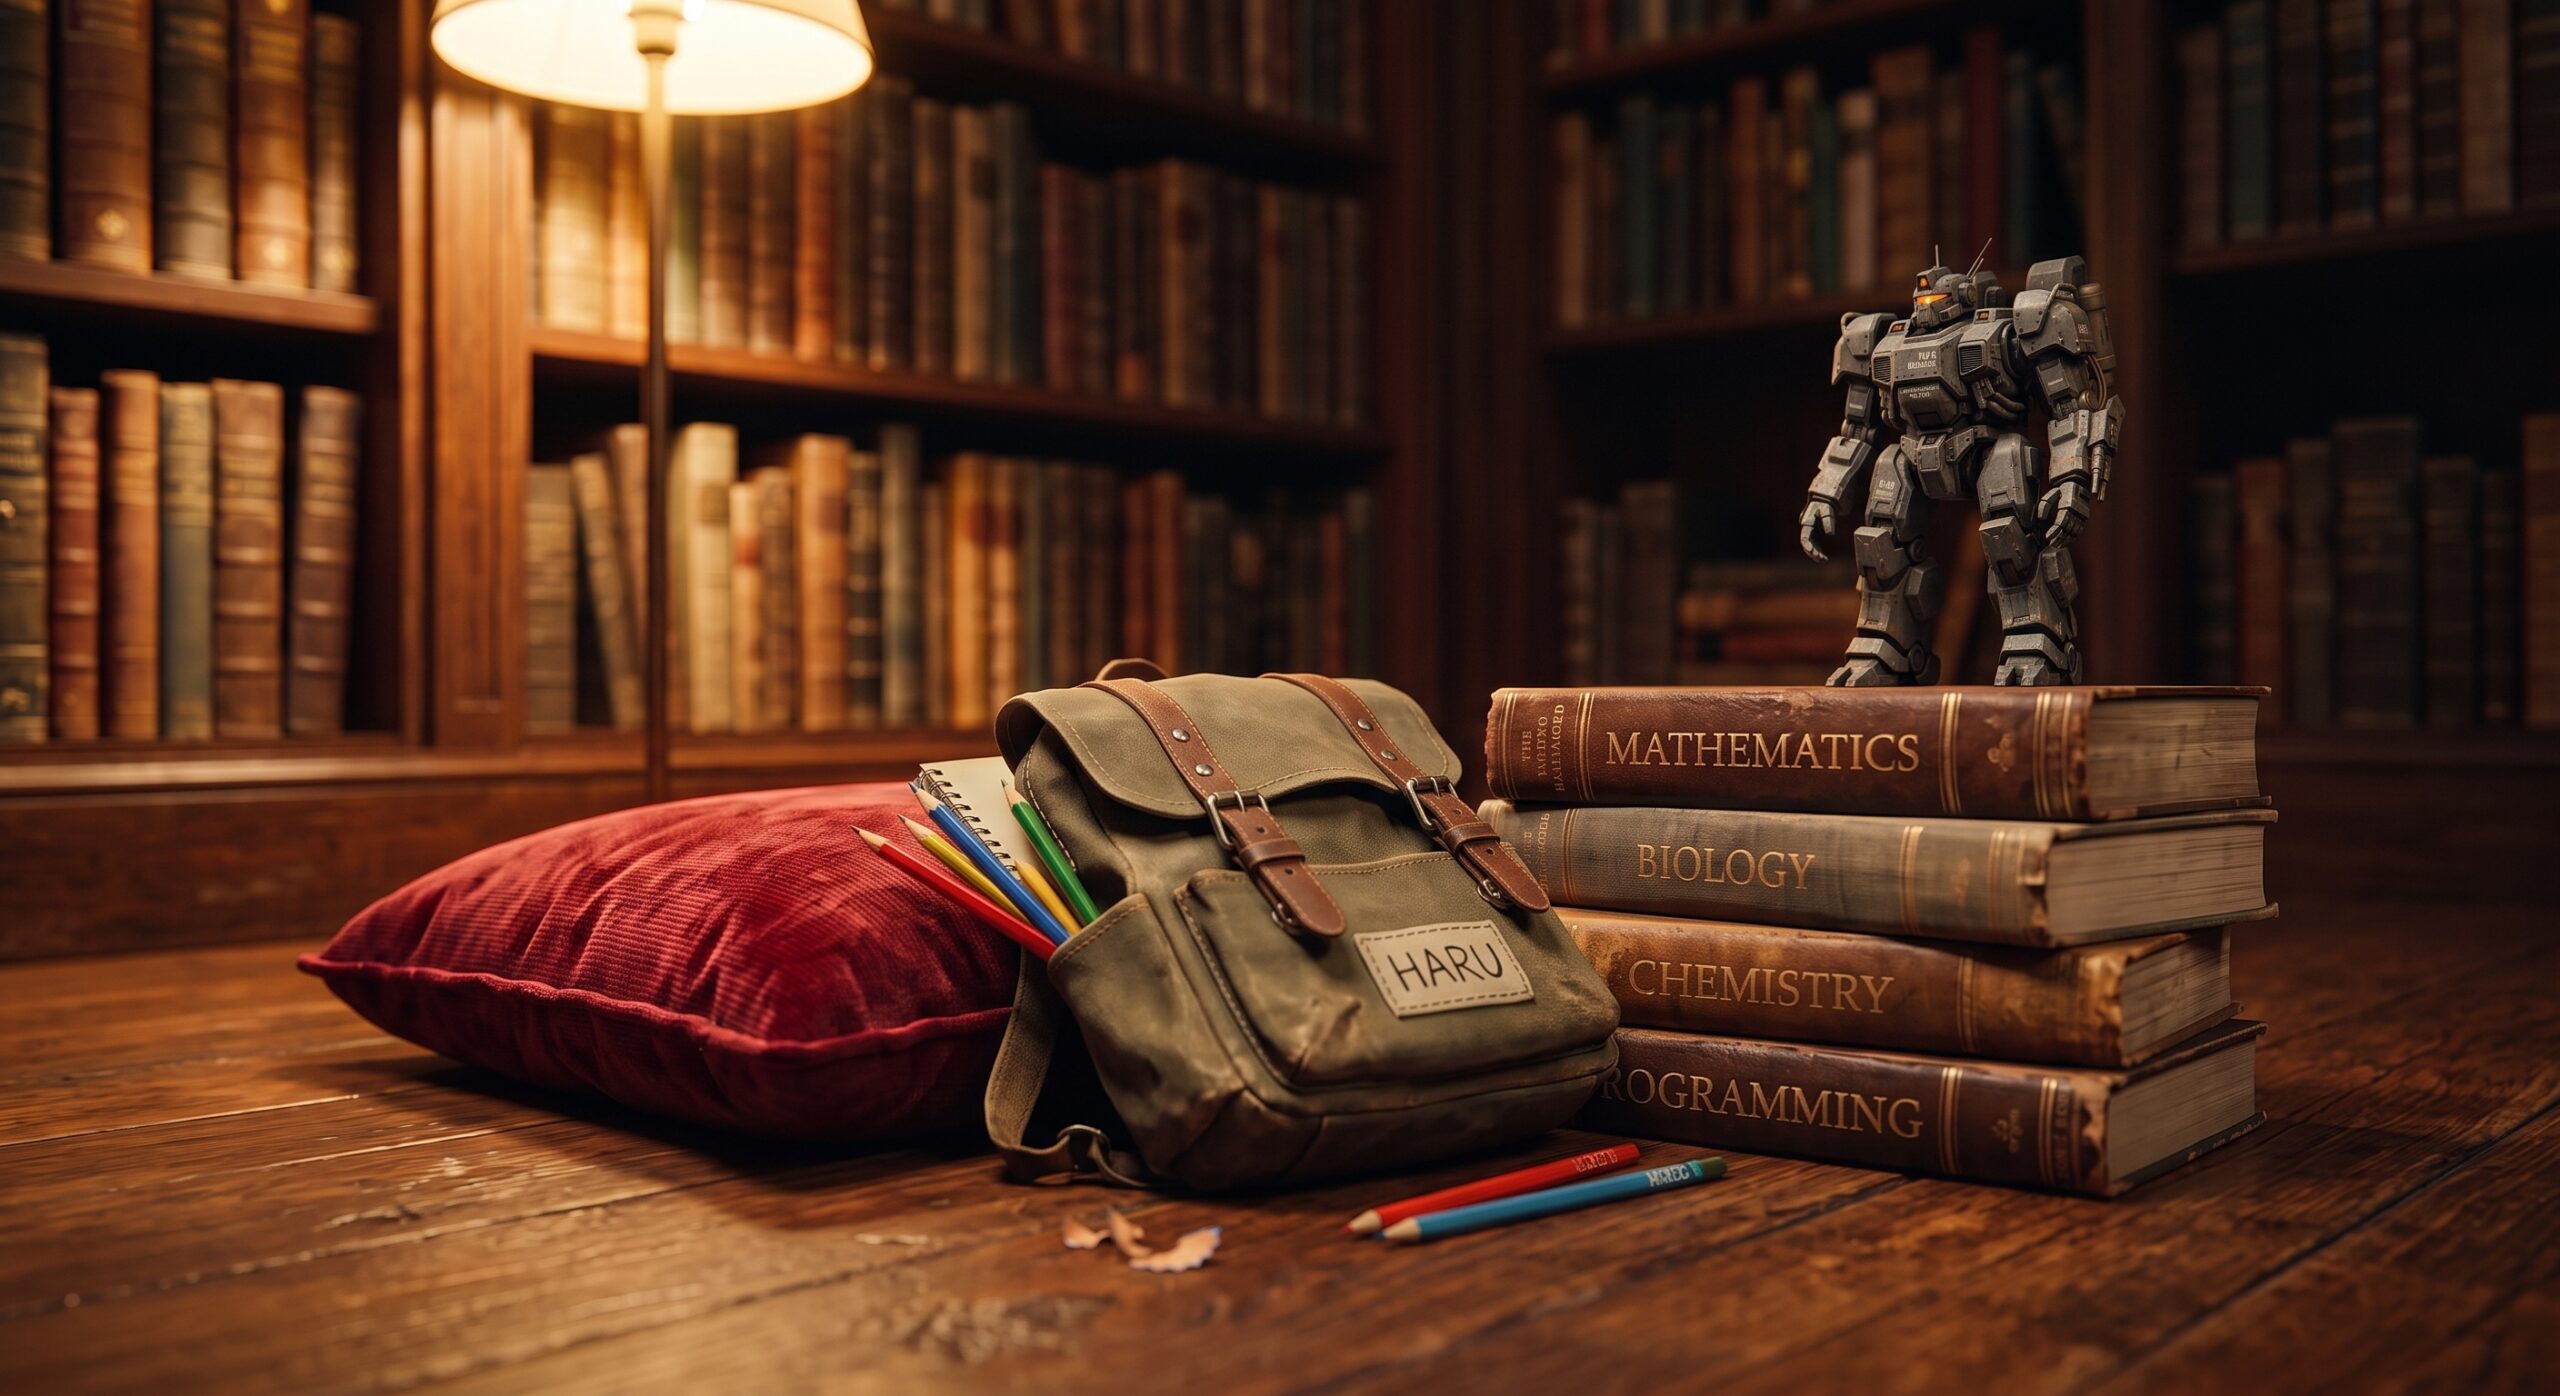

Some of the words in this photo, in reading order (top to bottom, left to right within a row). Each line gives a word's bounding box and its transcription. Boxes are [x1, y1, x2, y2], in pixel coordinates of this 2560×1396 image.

[1605, 731, 1920, 773] MATHEMATICS
[1636, 843, 1816, 891] BIOLOGY
[1387, 942, 1503, 992] HARU
[1628, 959, 1896, 1015] CHEMISTRY
[1599, 1066, 1924, 1140] ROGRAMMING
